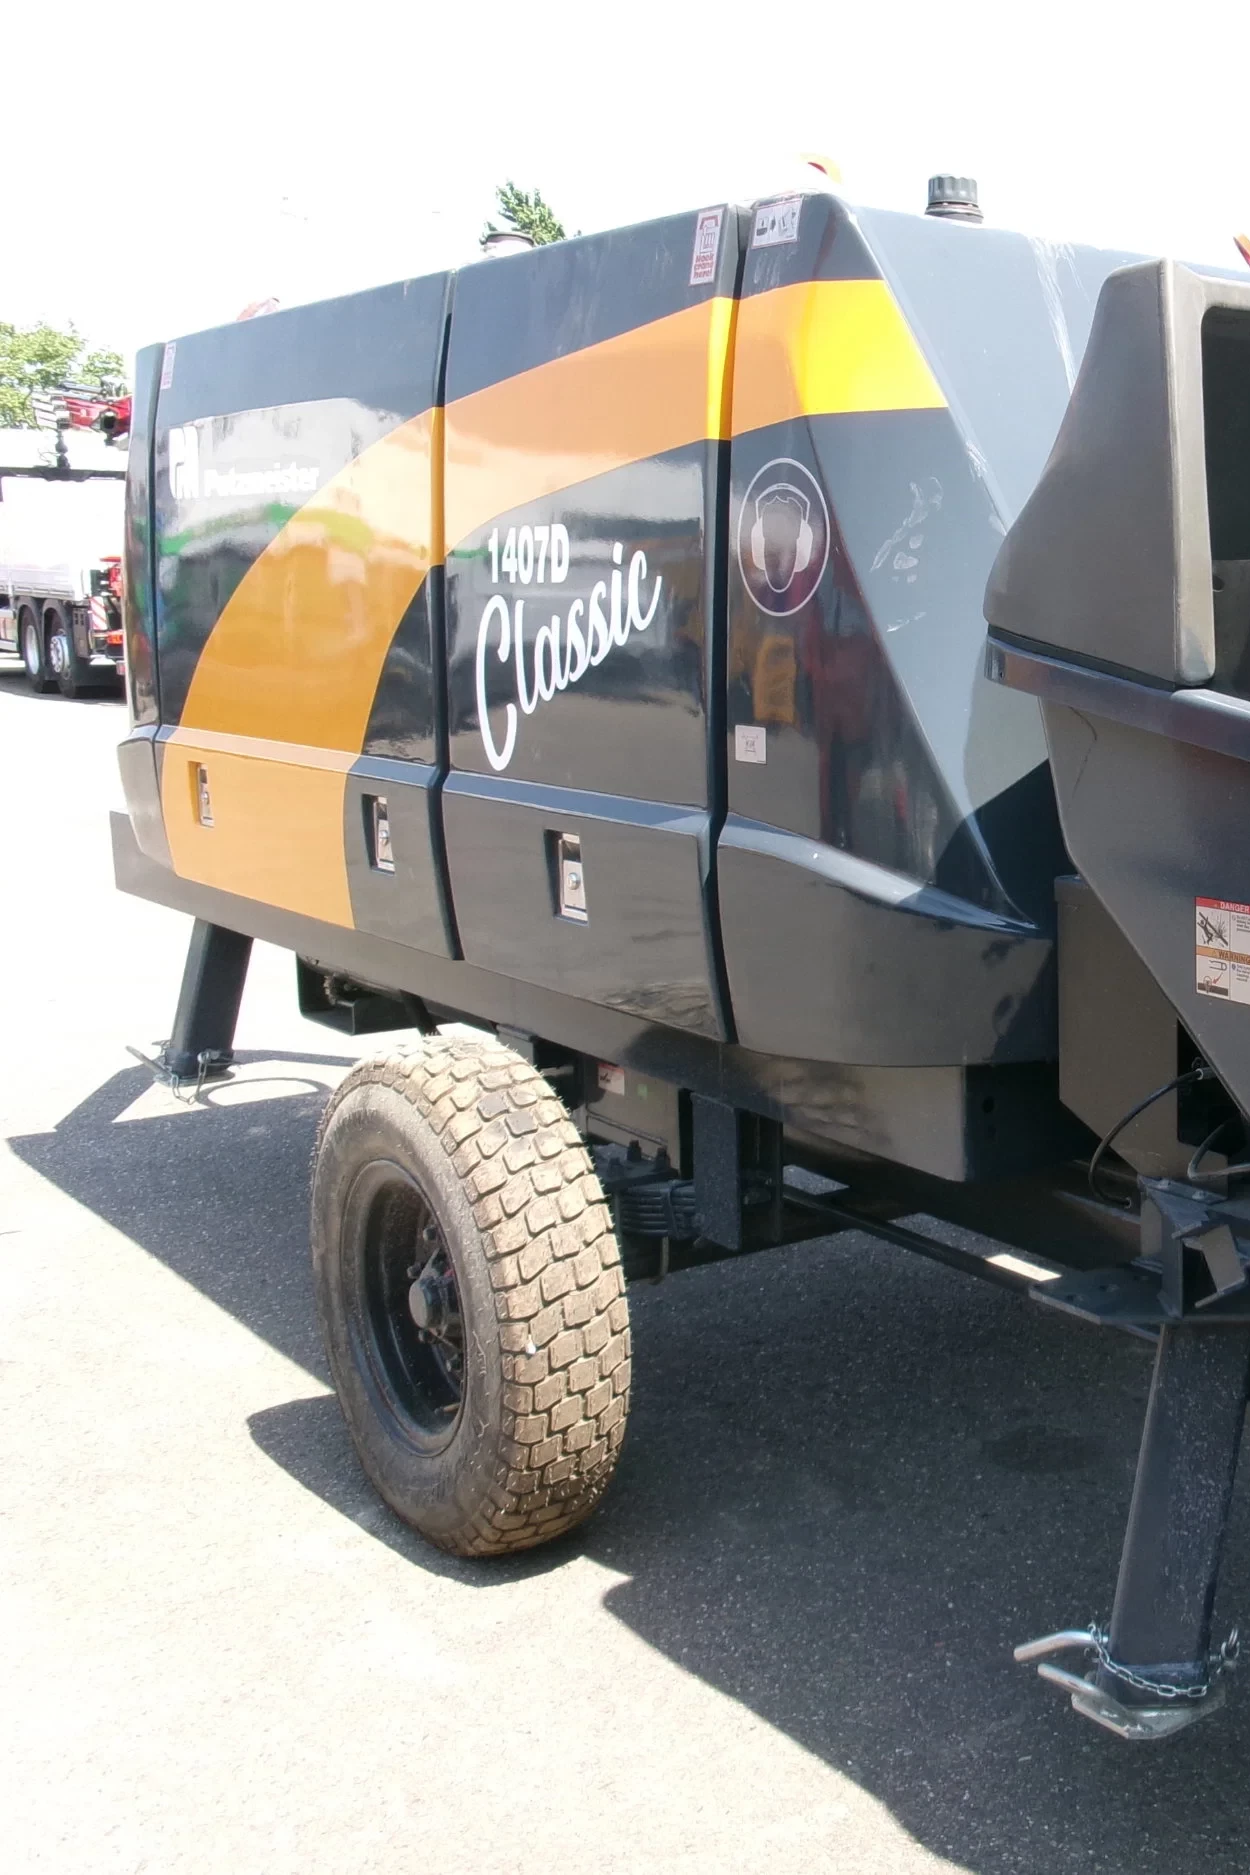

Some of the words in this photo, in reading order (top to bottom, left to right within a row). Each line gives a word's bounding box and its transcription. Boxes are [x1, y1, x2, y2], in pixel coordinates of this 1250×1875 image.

[488, 523, 569, 585] 1407D
[476, 541, 662, 771] Classic
[1220, 901, 1250, 915] DANGER
[1218, 951, 1250, 965] WARNING
